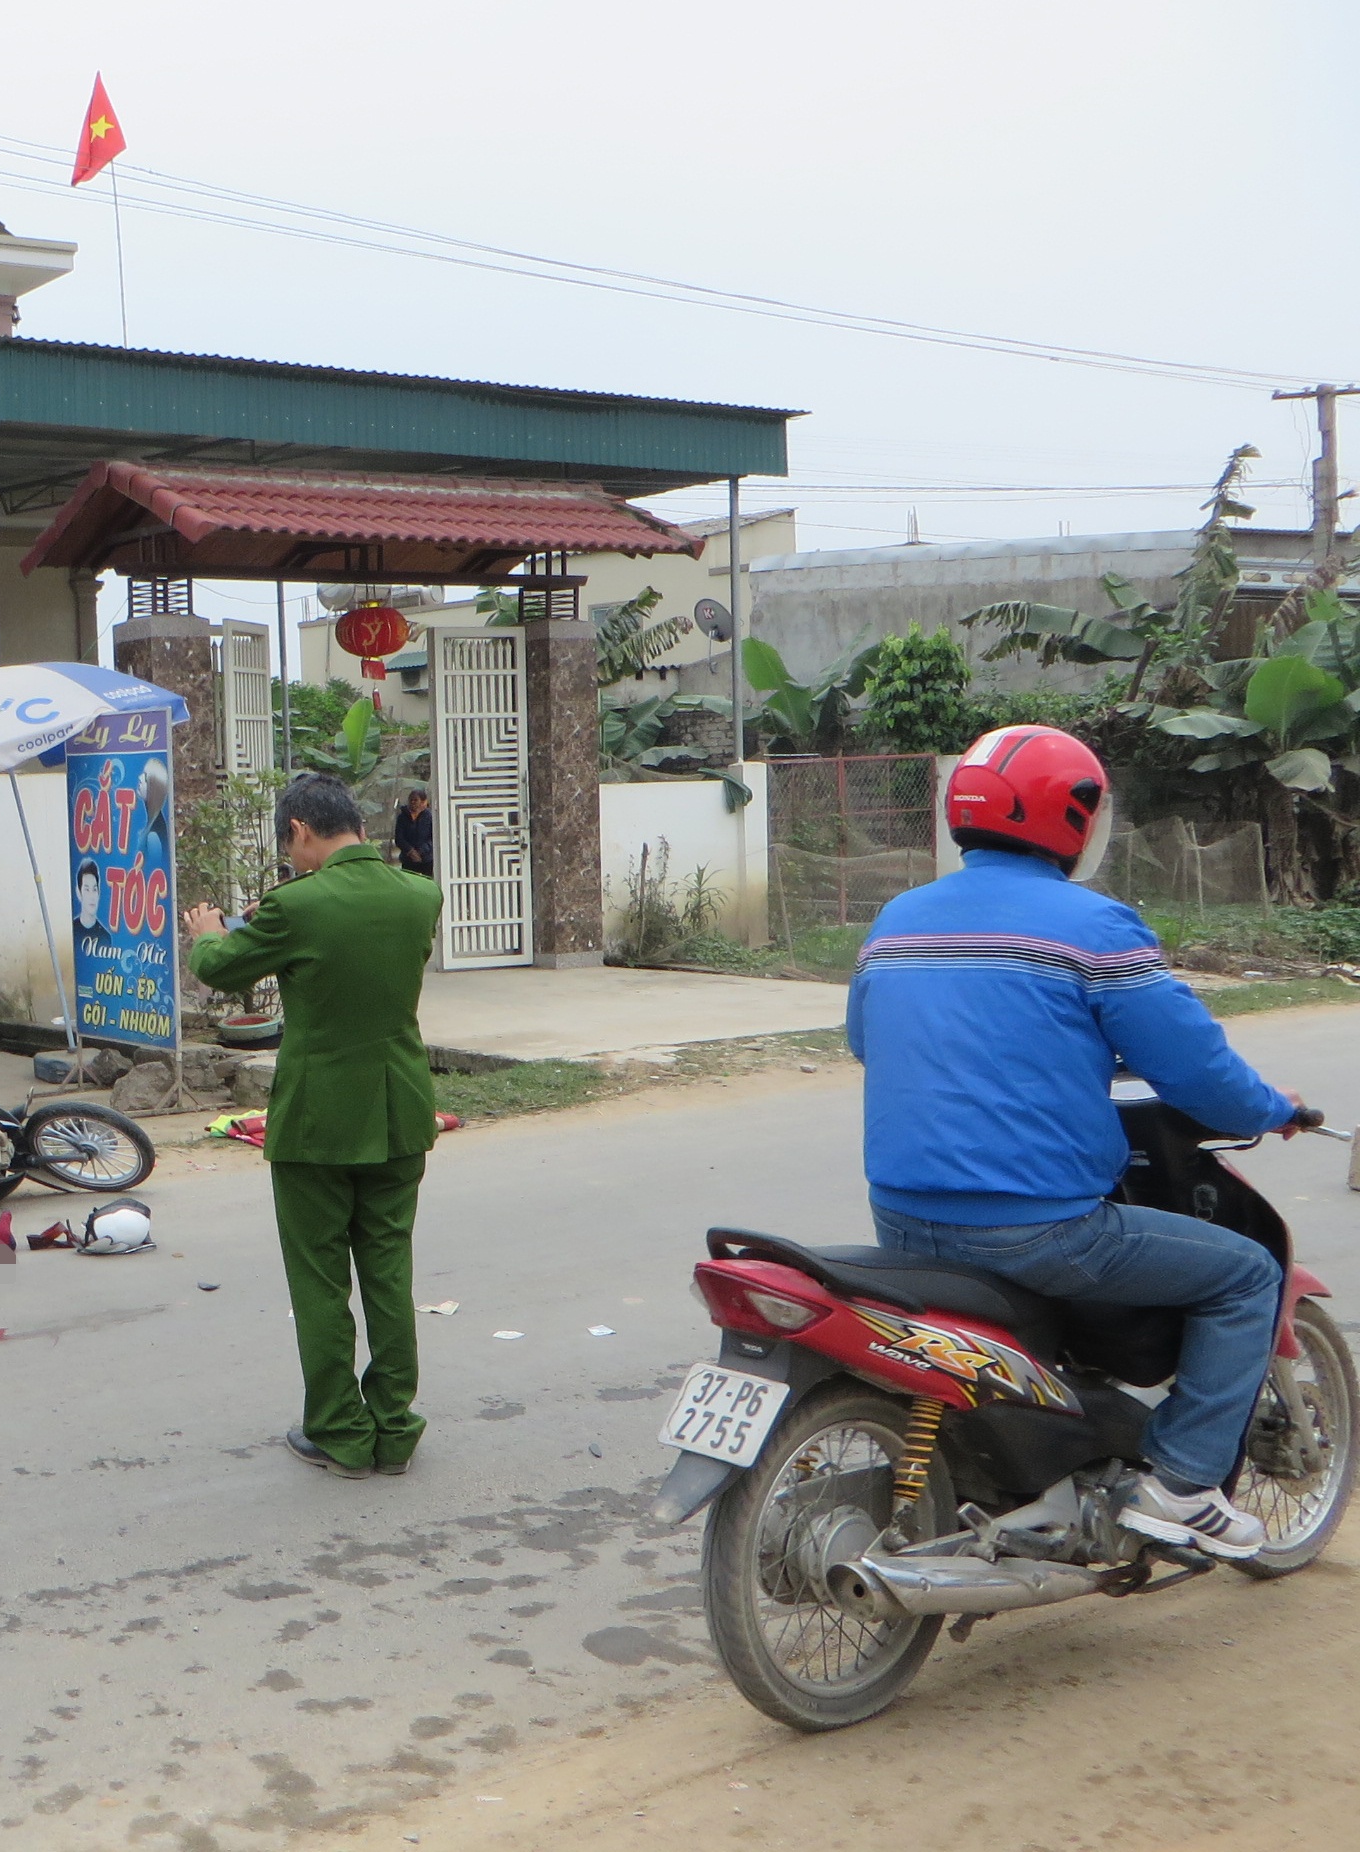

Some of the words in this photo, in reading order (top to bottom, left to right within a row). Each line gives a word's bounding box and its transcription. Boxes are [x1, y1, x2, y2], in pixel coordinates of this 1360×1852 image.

[74, 720, 112, 750] Ly
[119, 714, 159, 748] Ly
[74, 759, 136, 854] CẮT
[106, 851, 167, 937] TÓC
[81, 936, 122, 960] Nam
[95, 966, 123, 996] UỐN
[137, 973, 156, 1000] ÉP
[83, 1000, 107, 1029] GỘI
[119, 1009, 170, 1039] NHUỘM
[890, 1326, 998, 1382] RS
[674, 1407, 752, 1455] 2755
